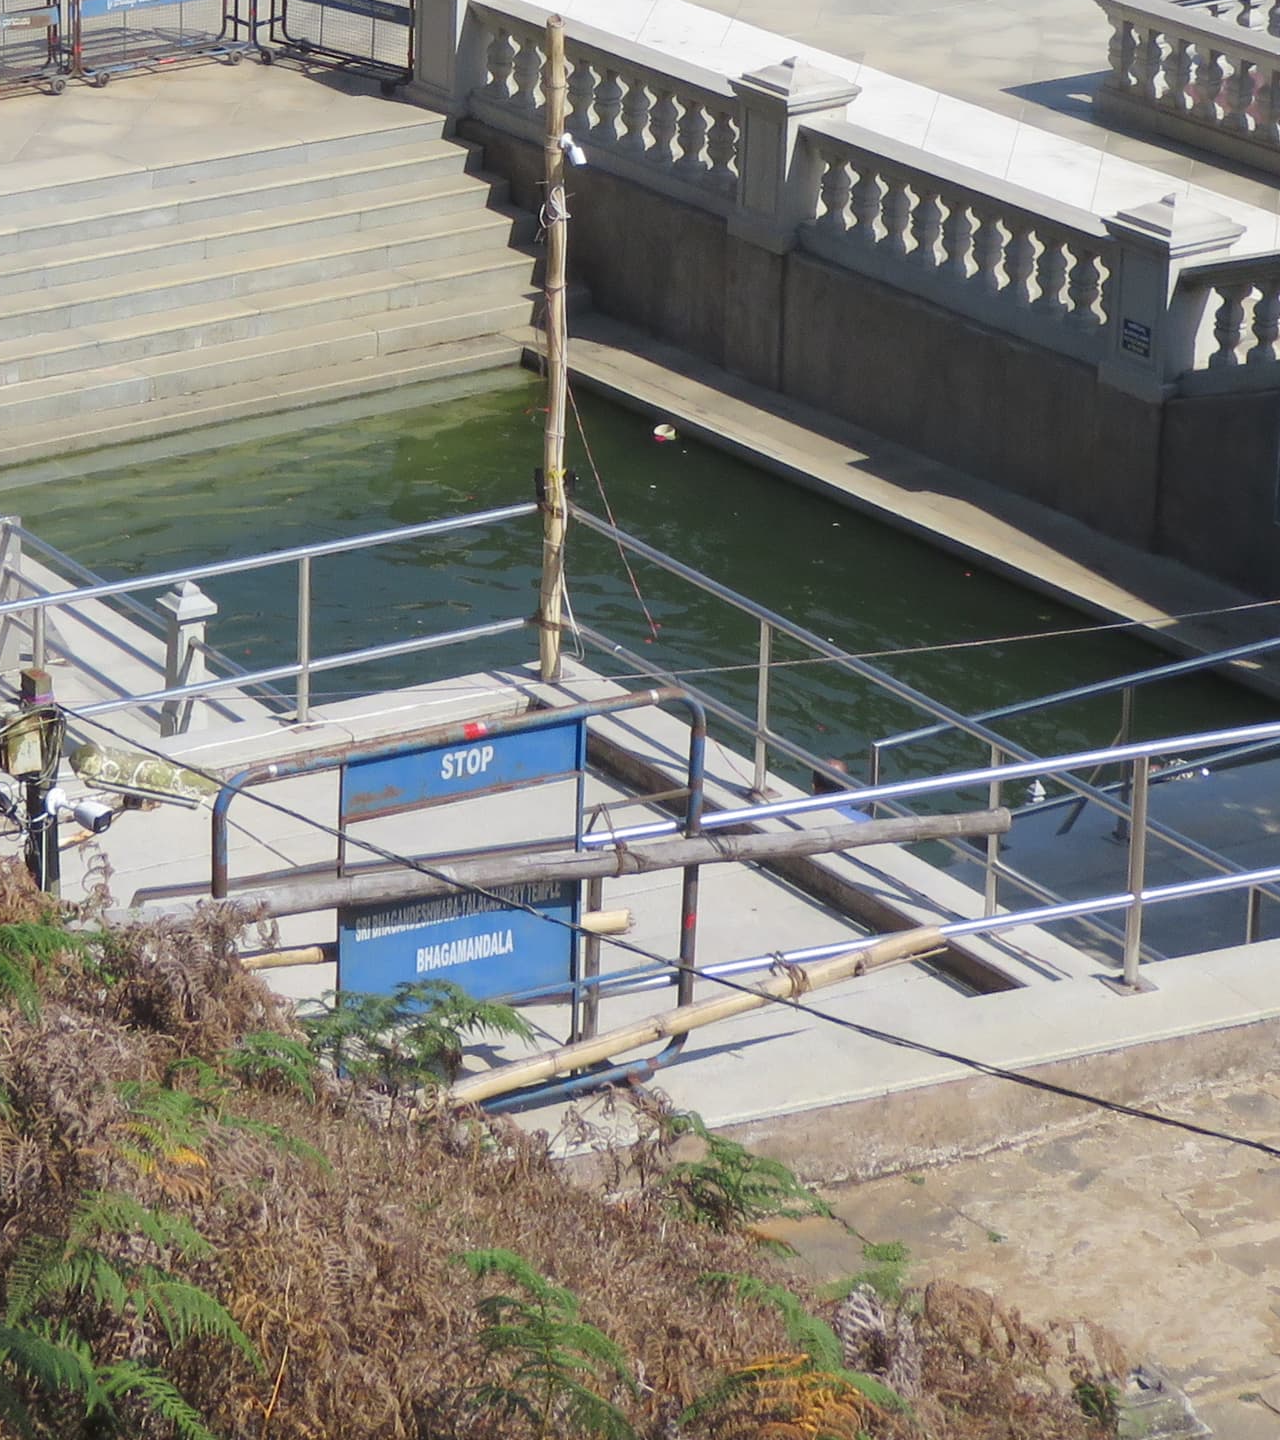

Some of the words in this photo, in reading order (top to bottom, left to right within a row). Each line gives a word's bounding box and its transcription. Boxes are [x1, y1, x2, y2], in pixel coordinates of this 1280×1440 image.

[441, 746, 494, 780] STOP
[355, 914, 372, 942] SRI
[526, 881, 561, 903] TEMPLE
[416, 929, 514, 973] BHAGAMANDALA
